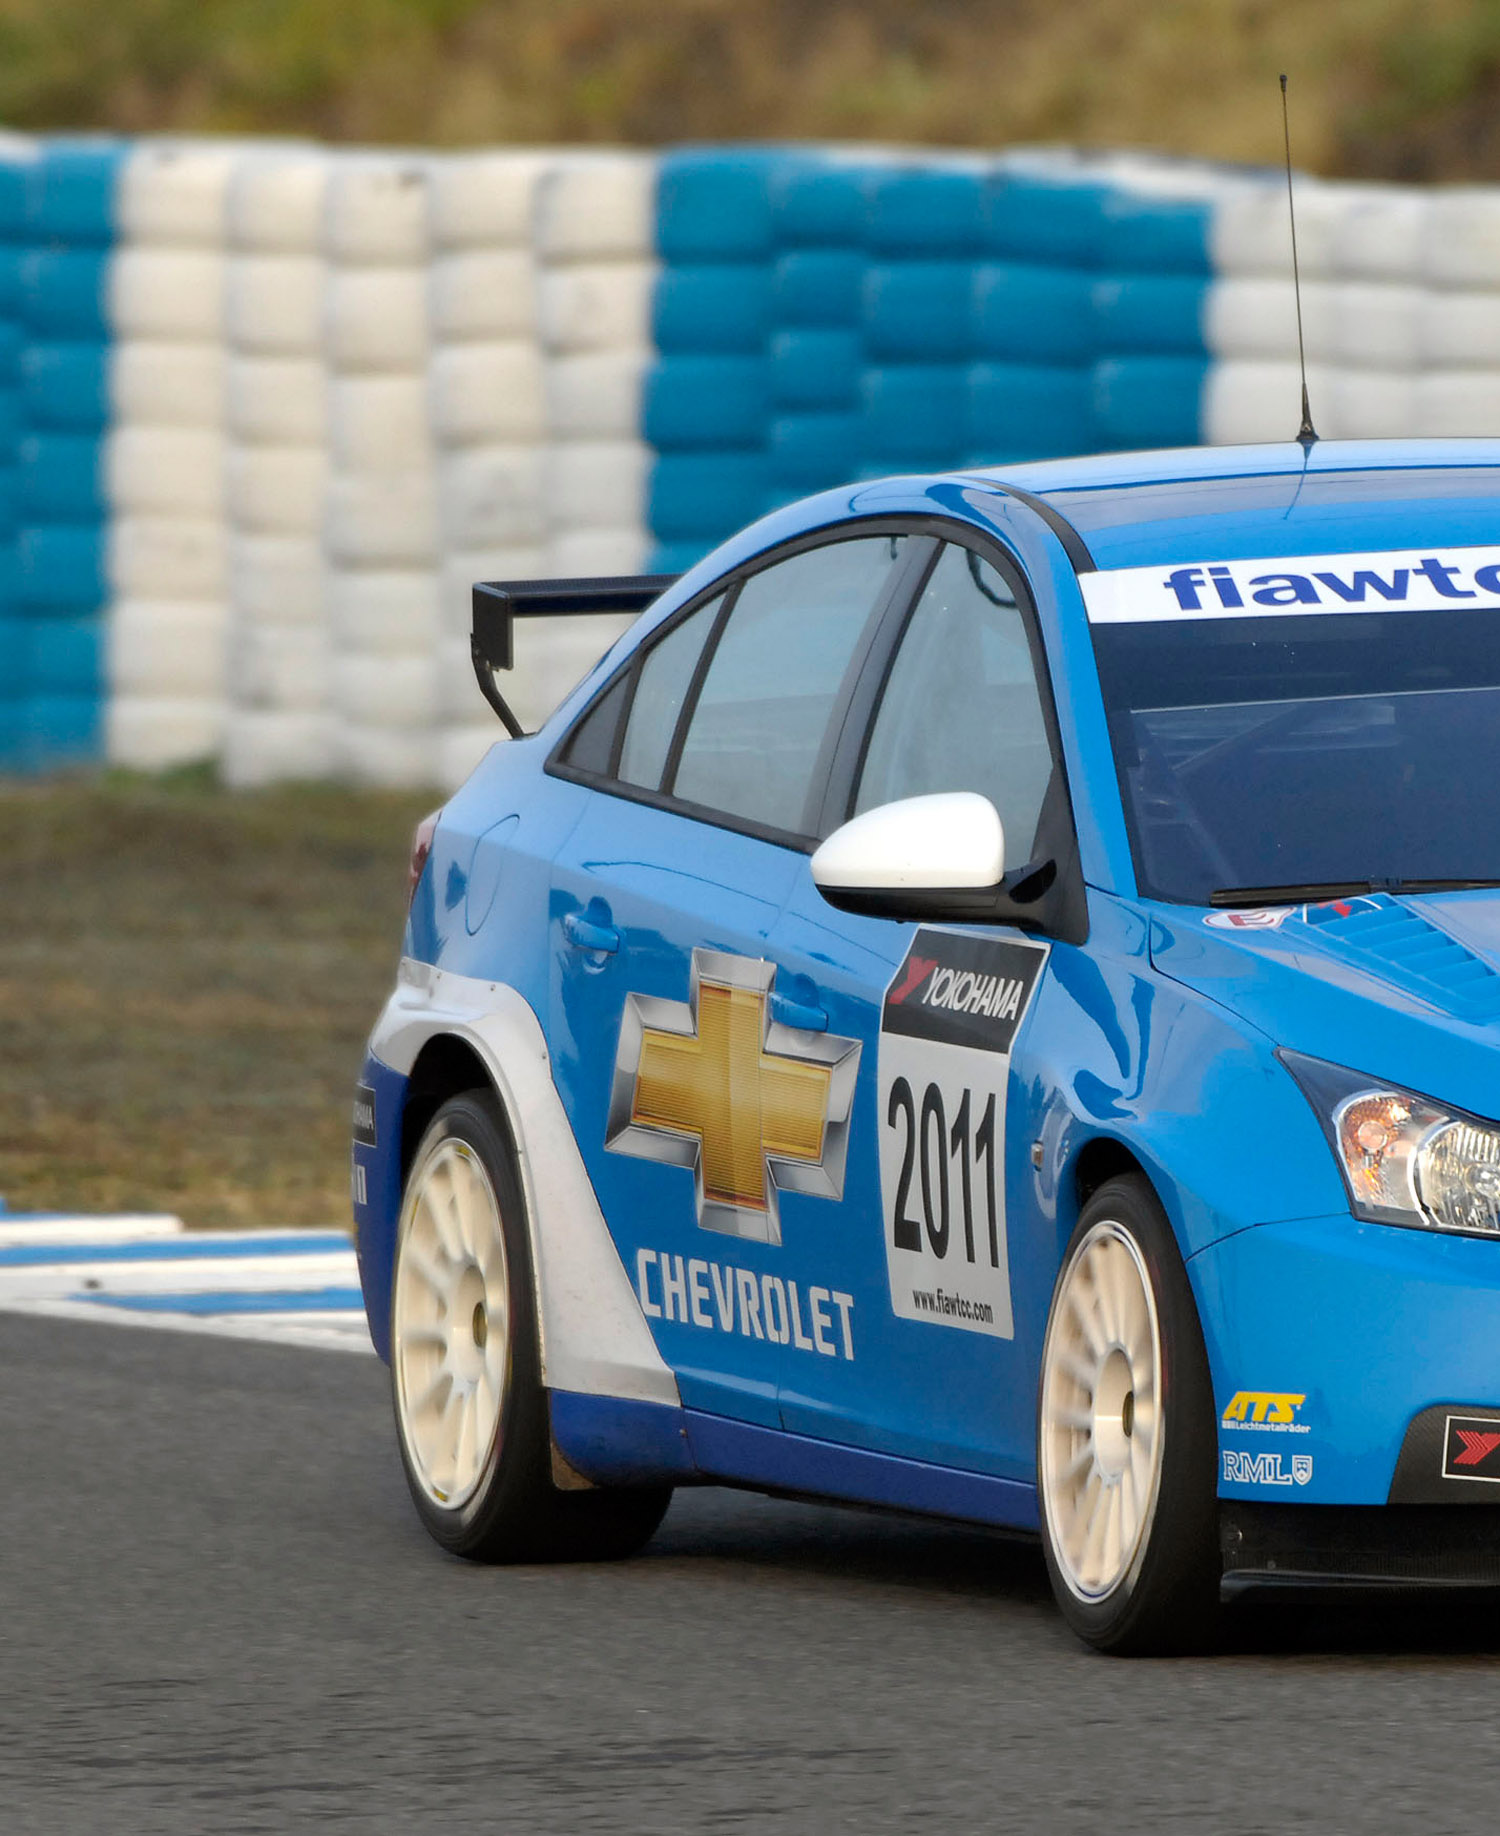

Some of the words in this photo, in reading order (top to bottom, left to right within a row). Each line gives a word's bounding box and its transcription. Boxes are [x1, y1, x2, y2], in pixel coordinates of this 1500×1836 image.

[922, 966, 1024, 1021] YOKOHAMA
[887, 1075, 999, 1269] 2011
[637, 1248, 855, 1362] CHEVROLET
[912, 1288, 994, 1324] www.fiawtcc.com
[1222, 1391, 1306, 1424] ATS
[1222, 1449, 1293, 1486] RML
